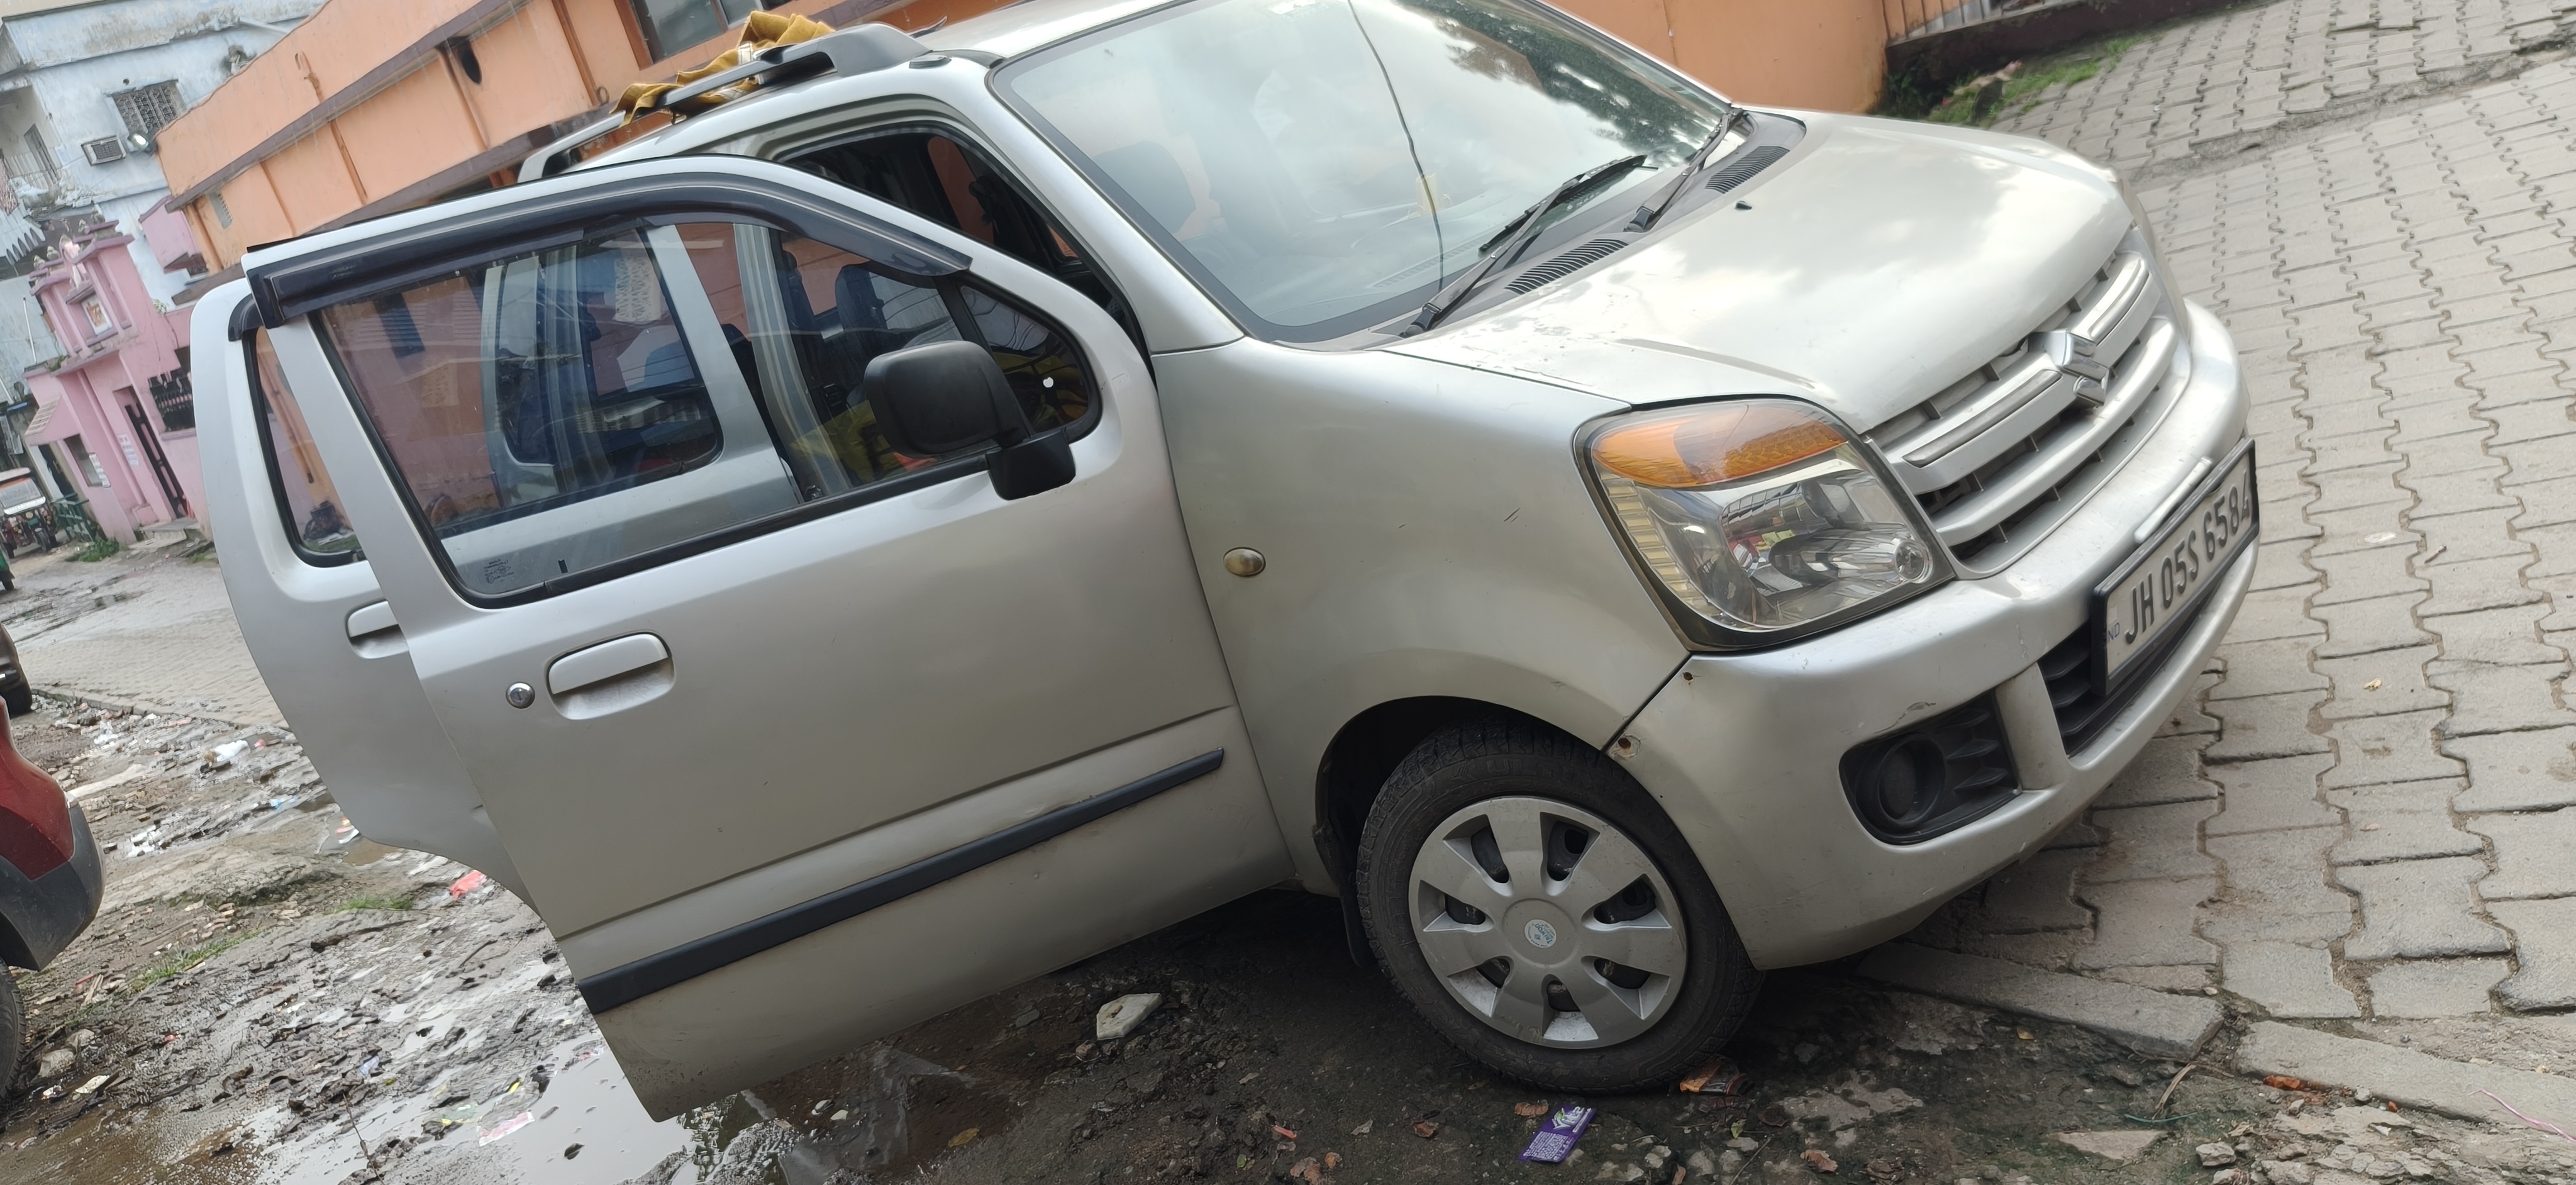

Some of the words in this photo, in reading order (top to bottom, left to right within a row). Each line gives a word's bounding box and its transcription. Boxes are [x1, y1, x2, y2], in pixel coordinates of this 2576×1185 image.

[2125, 573, 2155, 645] JH
[2160, 530, 2199, 609] 05S
[2203, 469, 2250, 562] 6584
